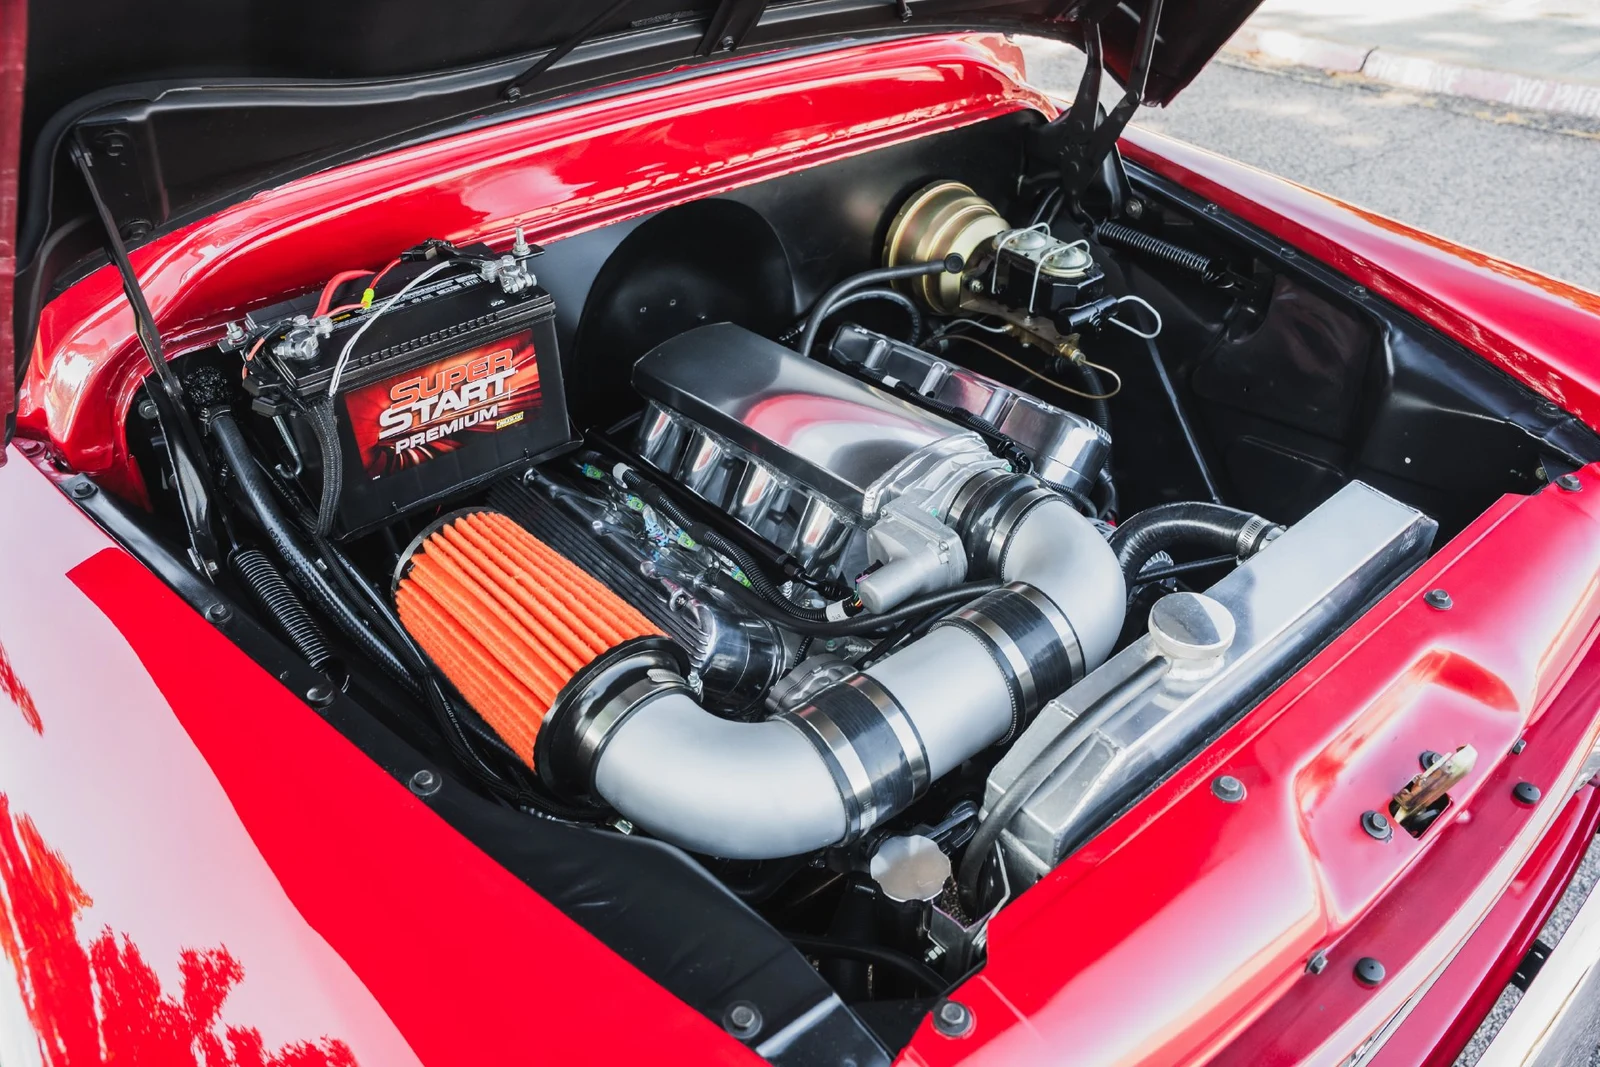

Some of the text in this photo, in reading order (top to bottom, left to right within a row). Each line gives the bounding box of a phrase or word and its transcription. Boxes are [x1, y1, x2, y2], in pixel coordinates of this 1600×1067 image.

[1505, 79, 1546, 107] NO
[1547, 81, 1600, 118] PAR
[379, 367, 518, 440] START
[390, 348, 514, 410] SUPER
[396, 404, 498, 455] PREMIUM
